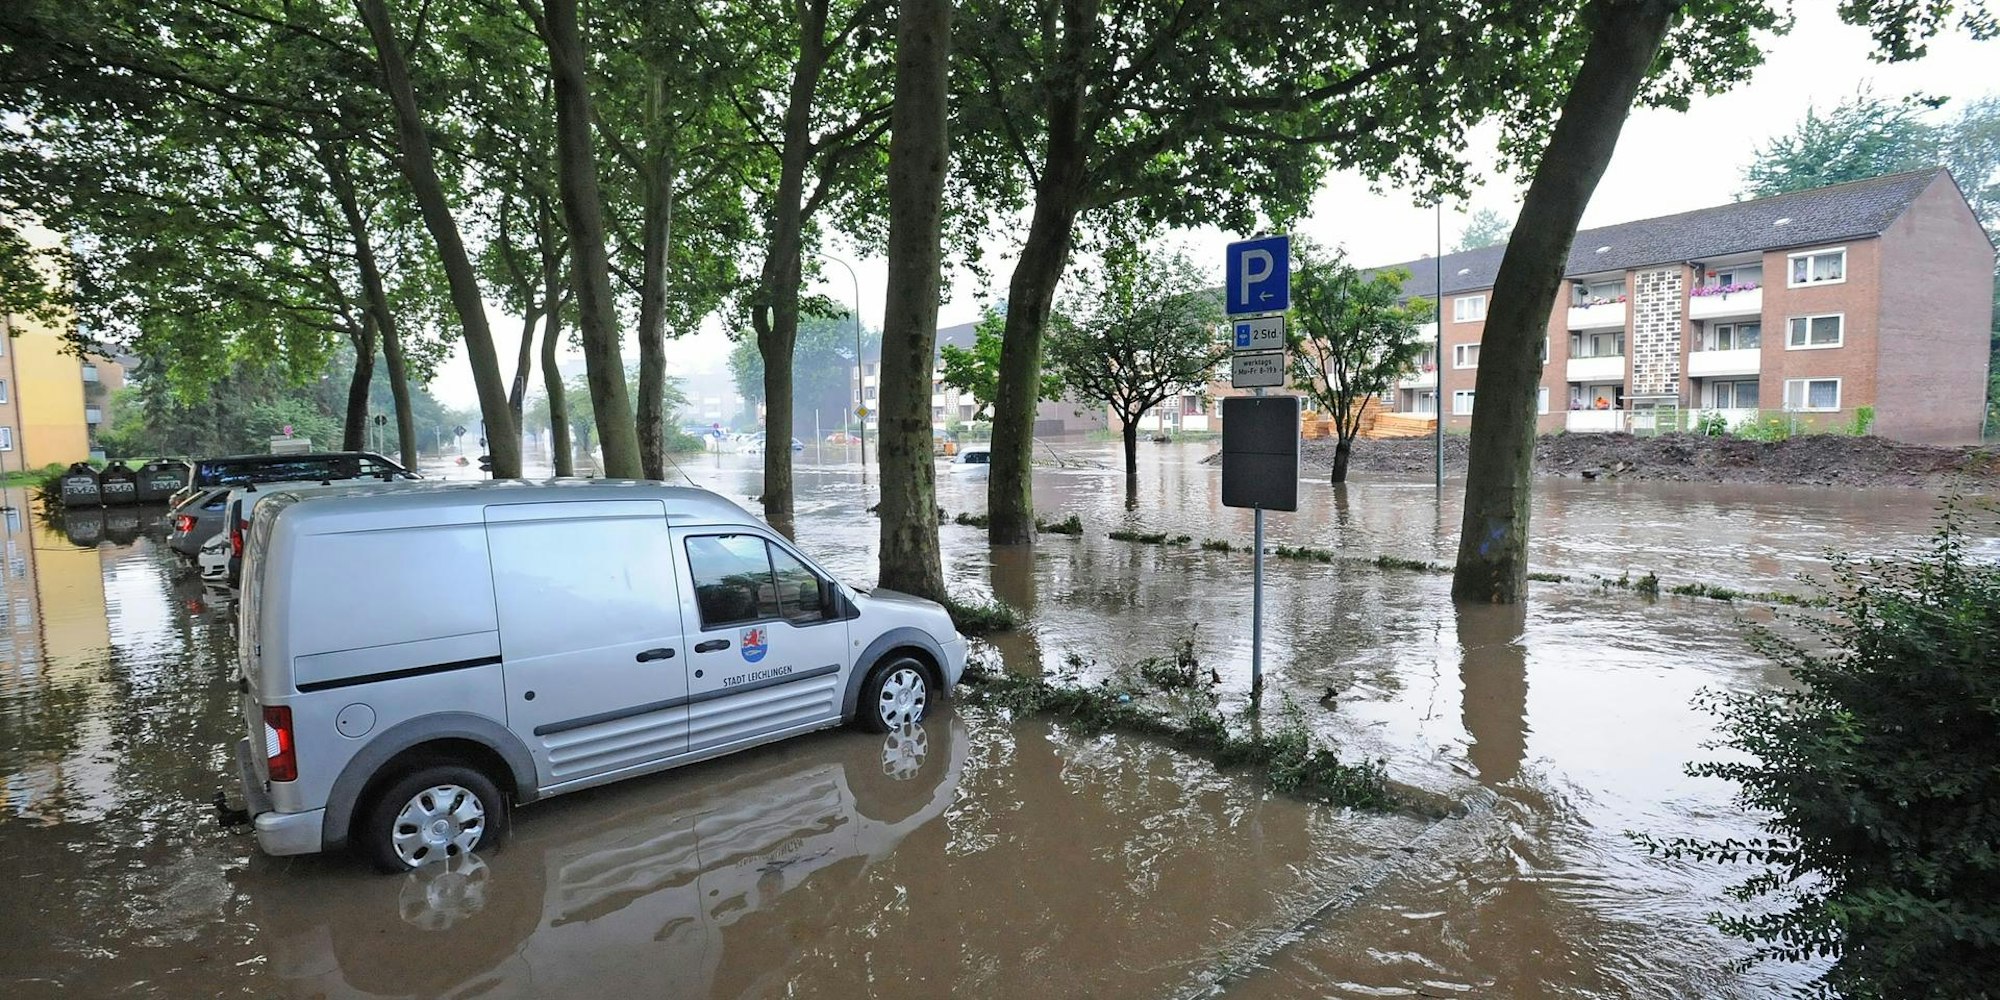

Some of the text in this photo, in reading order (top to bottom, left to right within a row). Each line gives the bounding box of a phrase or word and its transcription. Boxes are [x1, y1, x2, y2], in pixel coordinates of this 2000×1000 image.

[1241, 249, 1274, 305] P
[1253, 329, 1259, 339] 2
[723, 665, 793, 687] STADT LEICHLINGEN
